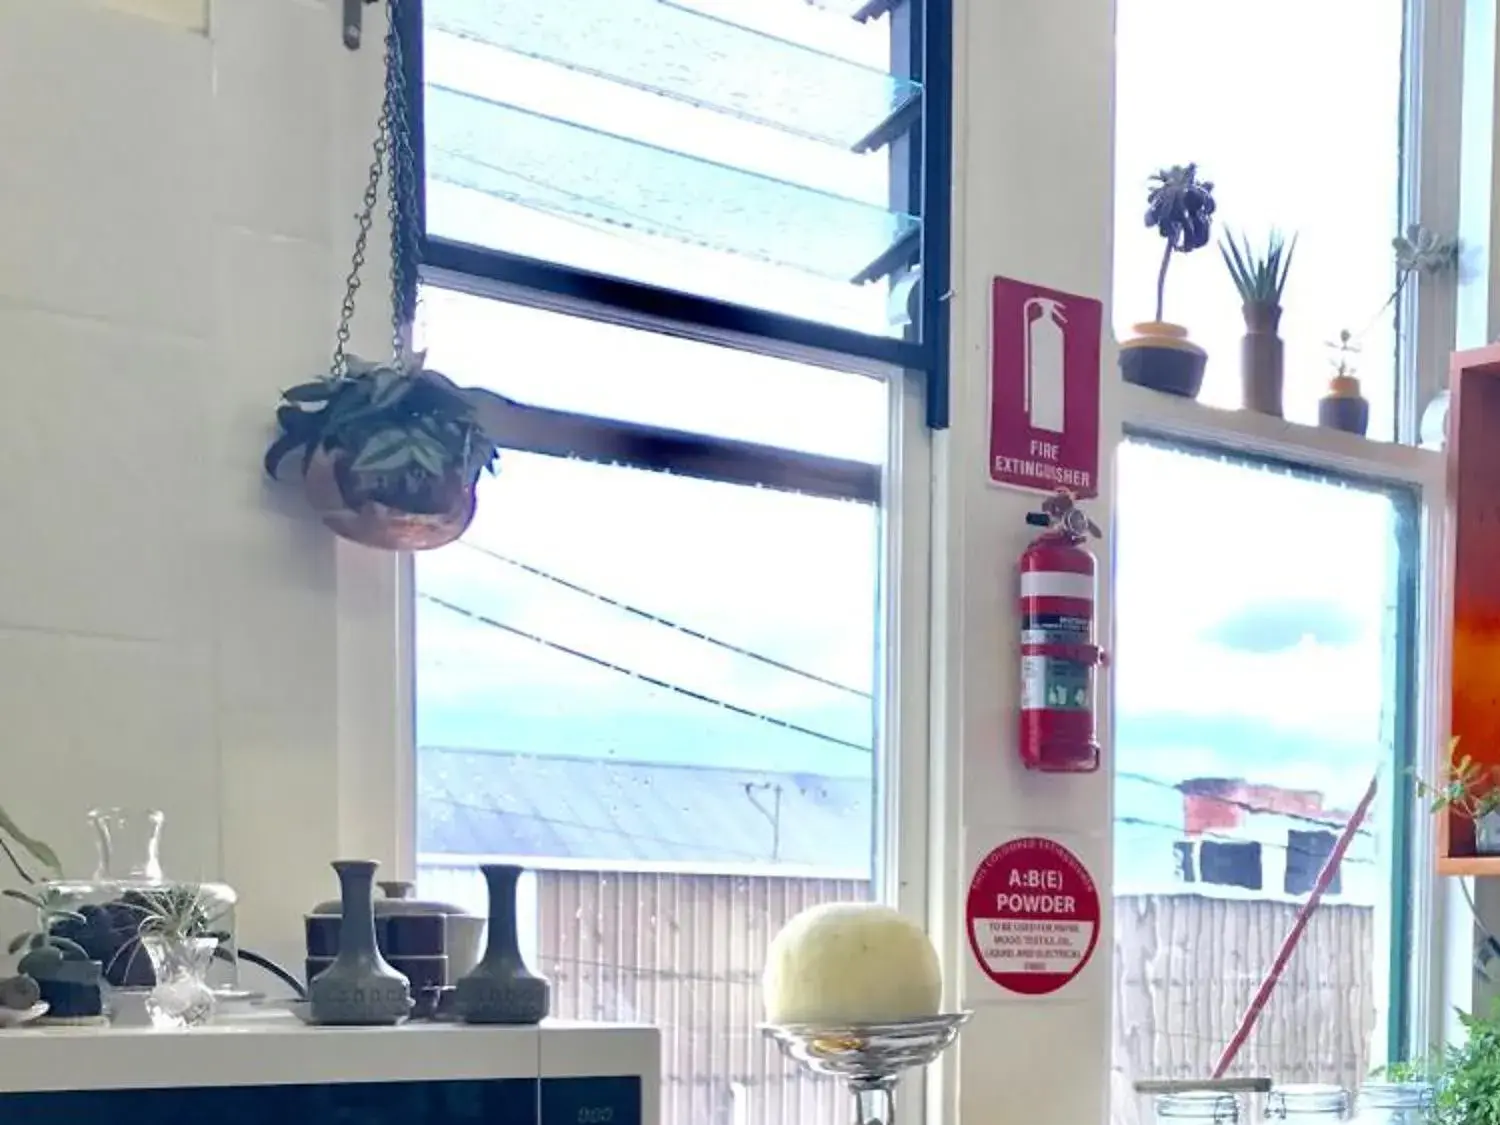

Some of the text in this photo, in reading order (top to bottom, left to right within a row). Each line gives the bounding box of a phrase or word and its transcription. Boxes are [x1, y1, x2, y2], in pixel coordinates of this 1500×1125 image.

[1030, 439, 1060, 461] FIRE
[995, 455, 1090, 487] EXTINGUISHER
[996, 893, 1076, 913] POWDER
